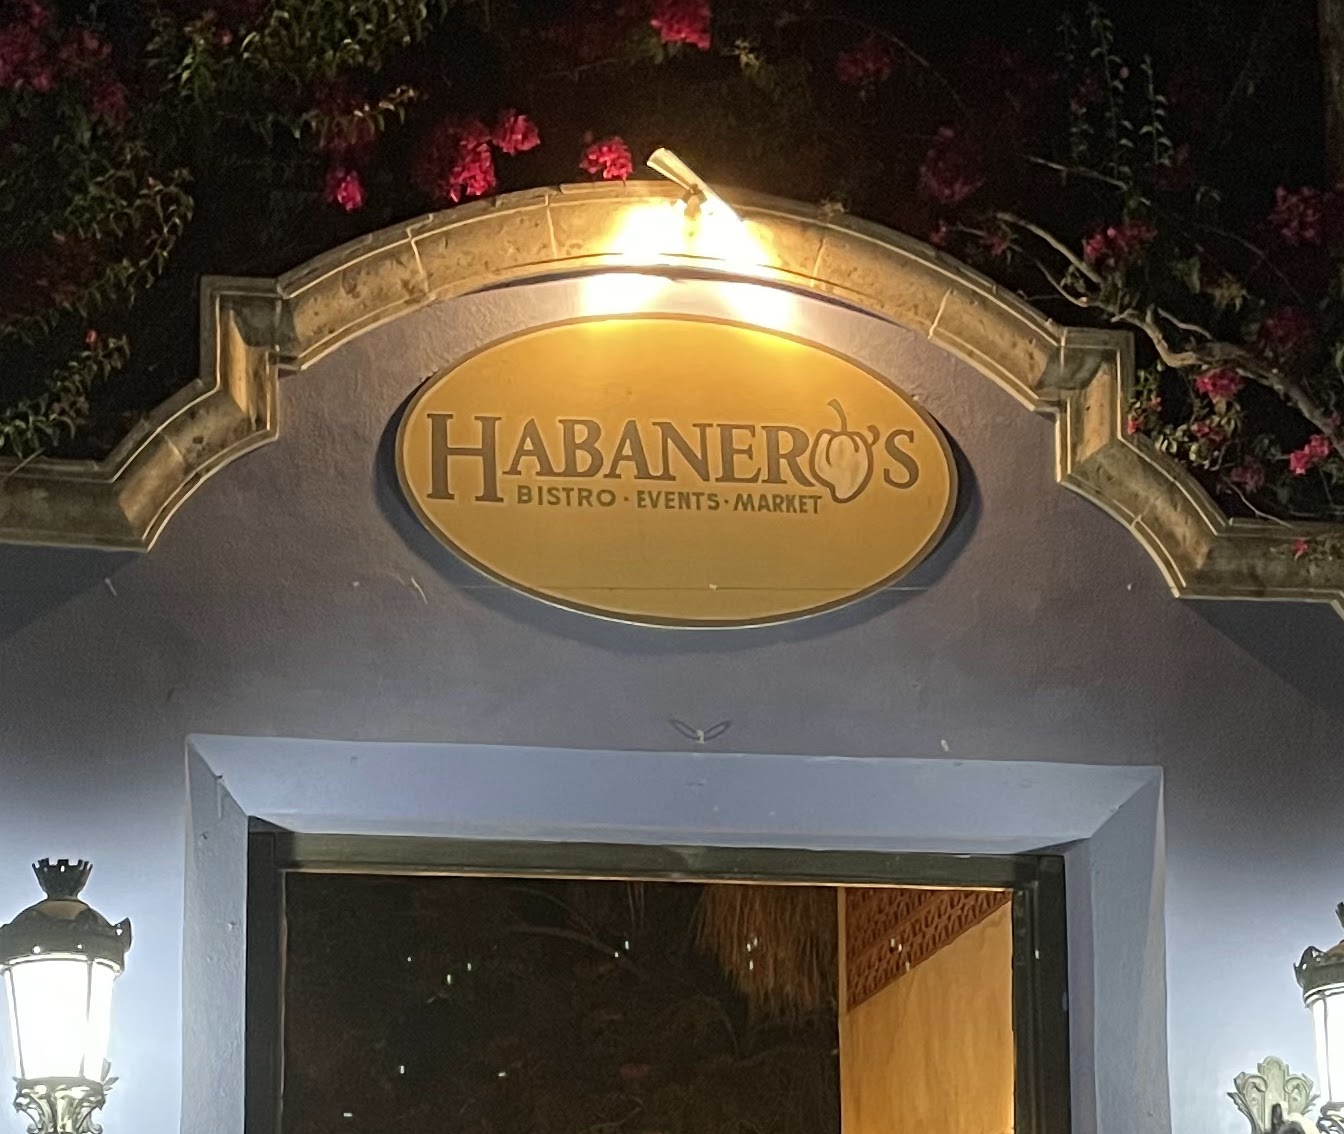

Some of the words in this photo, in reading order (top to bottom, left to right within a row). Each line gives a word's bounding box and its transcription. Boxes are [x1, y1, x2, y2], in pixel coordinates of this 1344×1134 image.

[426, 400, 920, 503] HABANERO'S
[517, 485, 616, 508] BISTRO
[637, 489, 720, 511] EVENTS
[733, 493, 823, 514] MARKET
